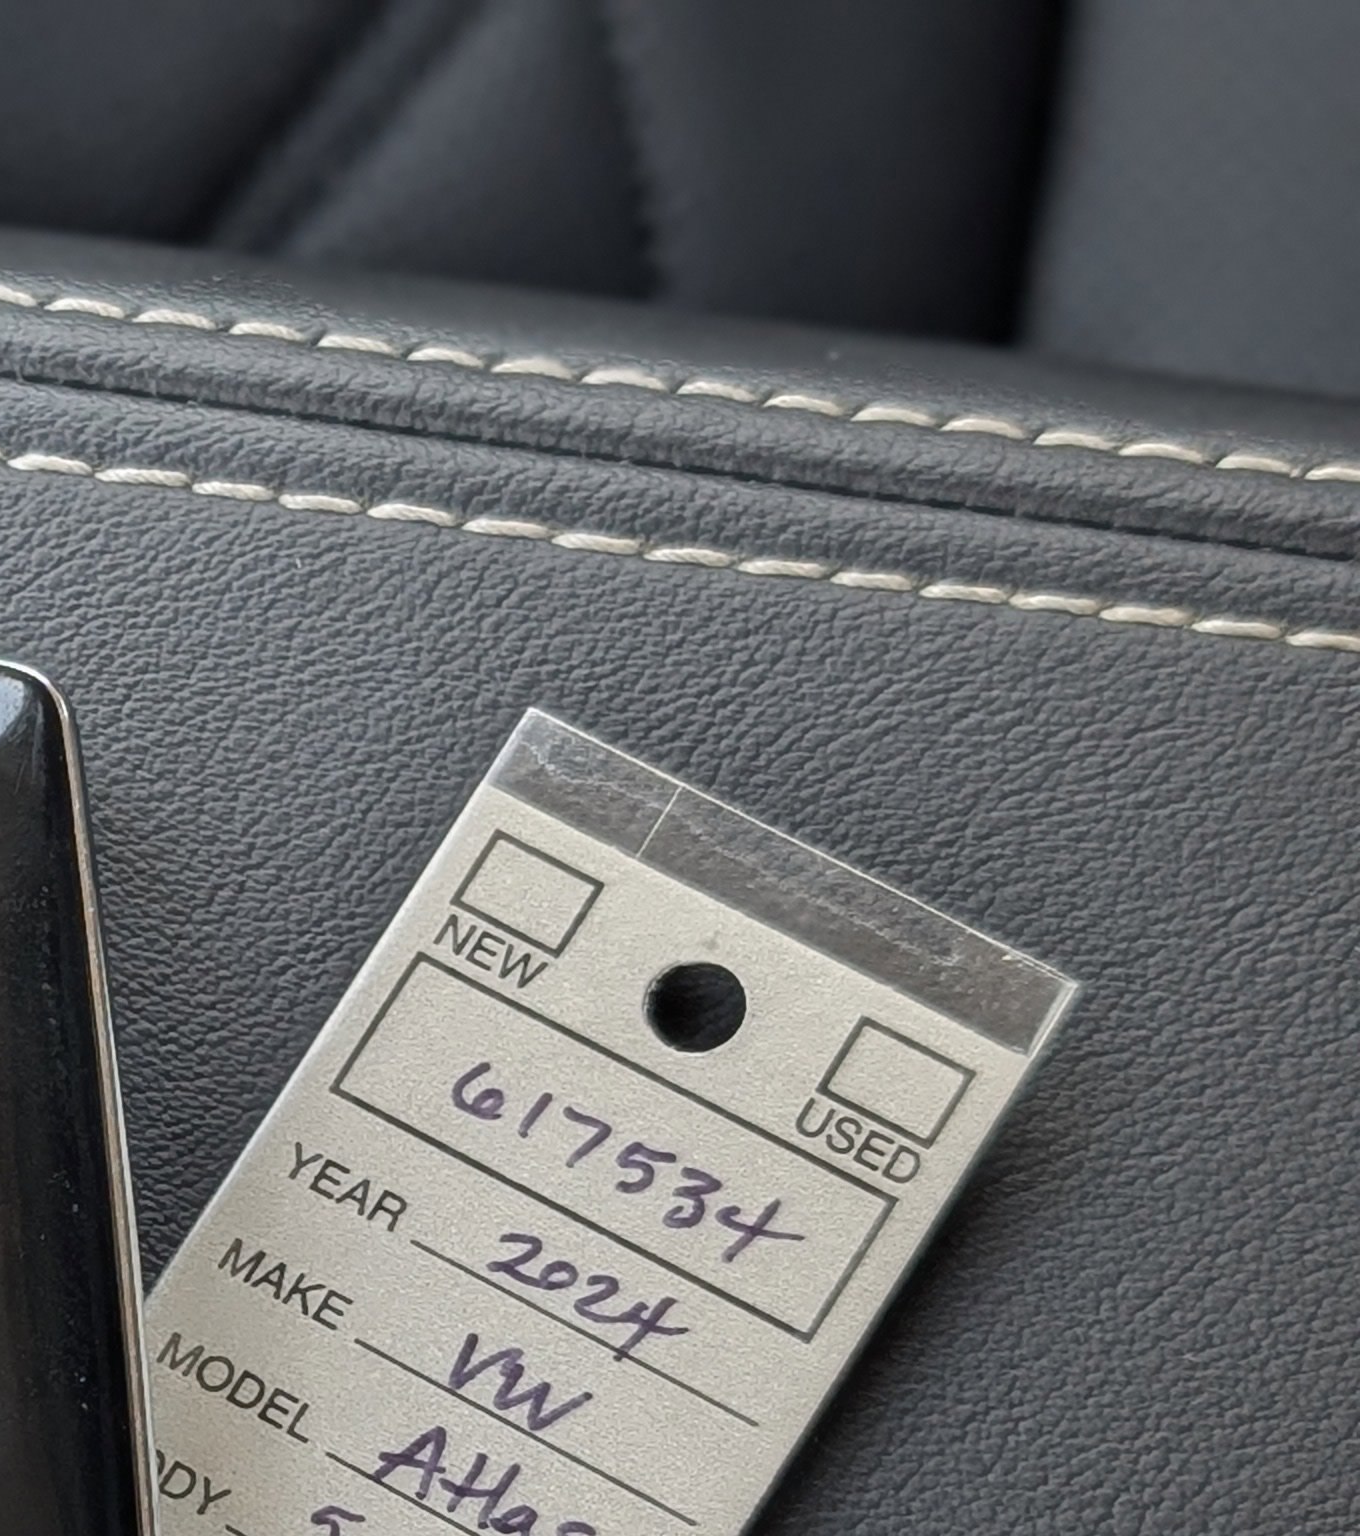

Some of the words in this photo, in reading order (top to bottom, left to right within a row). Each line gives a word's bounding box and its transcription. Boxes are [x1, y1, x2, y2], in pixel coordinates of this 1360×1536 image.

[433, 912, 550, 991] NEW
[284, 1142, 412, 1233] YEAR
[451, 1061, 805, 1262] 617534
[794, 1098, 921, 1185] USED
[218, 1237, 353, 1332] MAKE
[486, 1232, 689, 1362] 2024
[156, 1332, 309, 1443] MODEL
[448, 1332, 594, 1432] VW
[155, 1449, 232, 1515] DY
